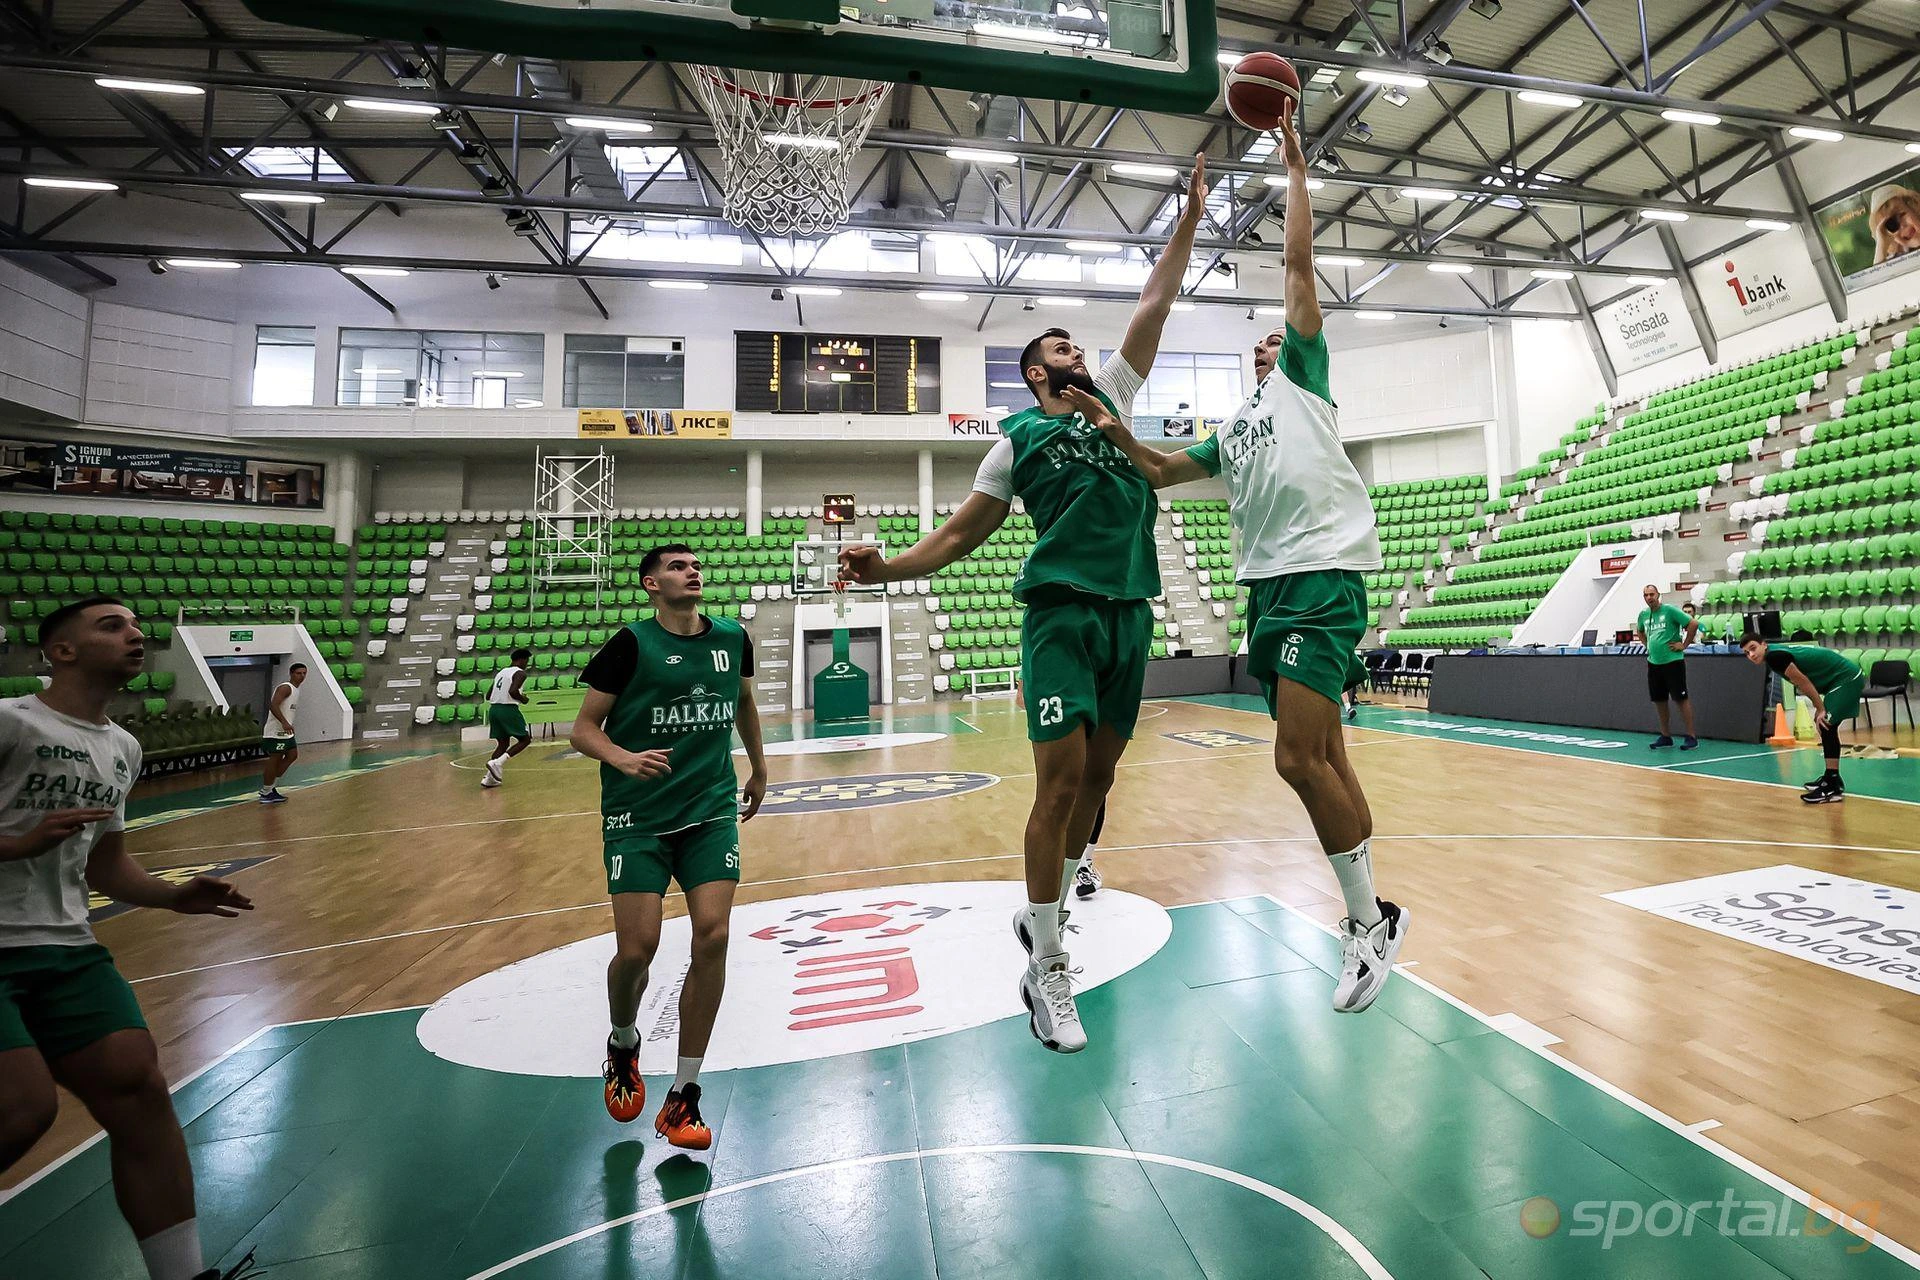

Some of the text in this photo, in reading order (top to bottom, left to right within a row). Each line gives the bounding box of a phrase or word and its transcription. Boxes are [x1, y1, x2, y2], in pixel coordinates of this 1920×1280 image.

[1620, 312, 1669, 340] Sensata
[681, 418, 716, 428] ЛКС
[953, 419, 1002, 435] KRIL
[711, 649, 730, 673] 10
[652, 700, 734, 725] BALKAN
[1038, 696, 1064, 726] 23
[276, 742, 286, 751] 22
[610, 854, 623, 881] 10
